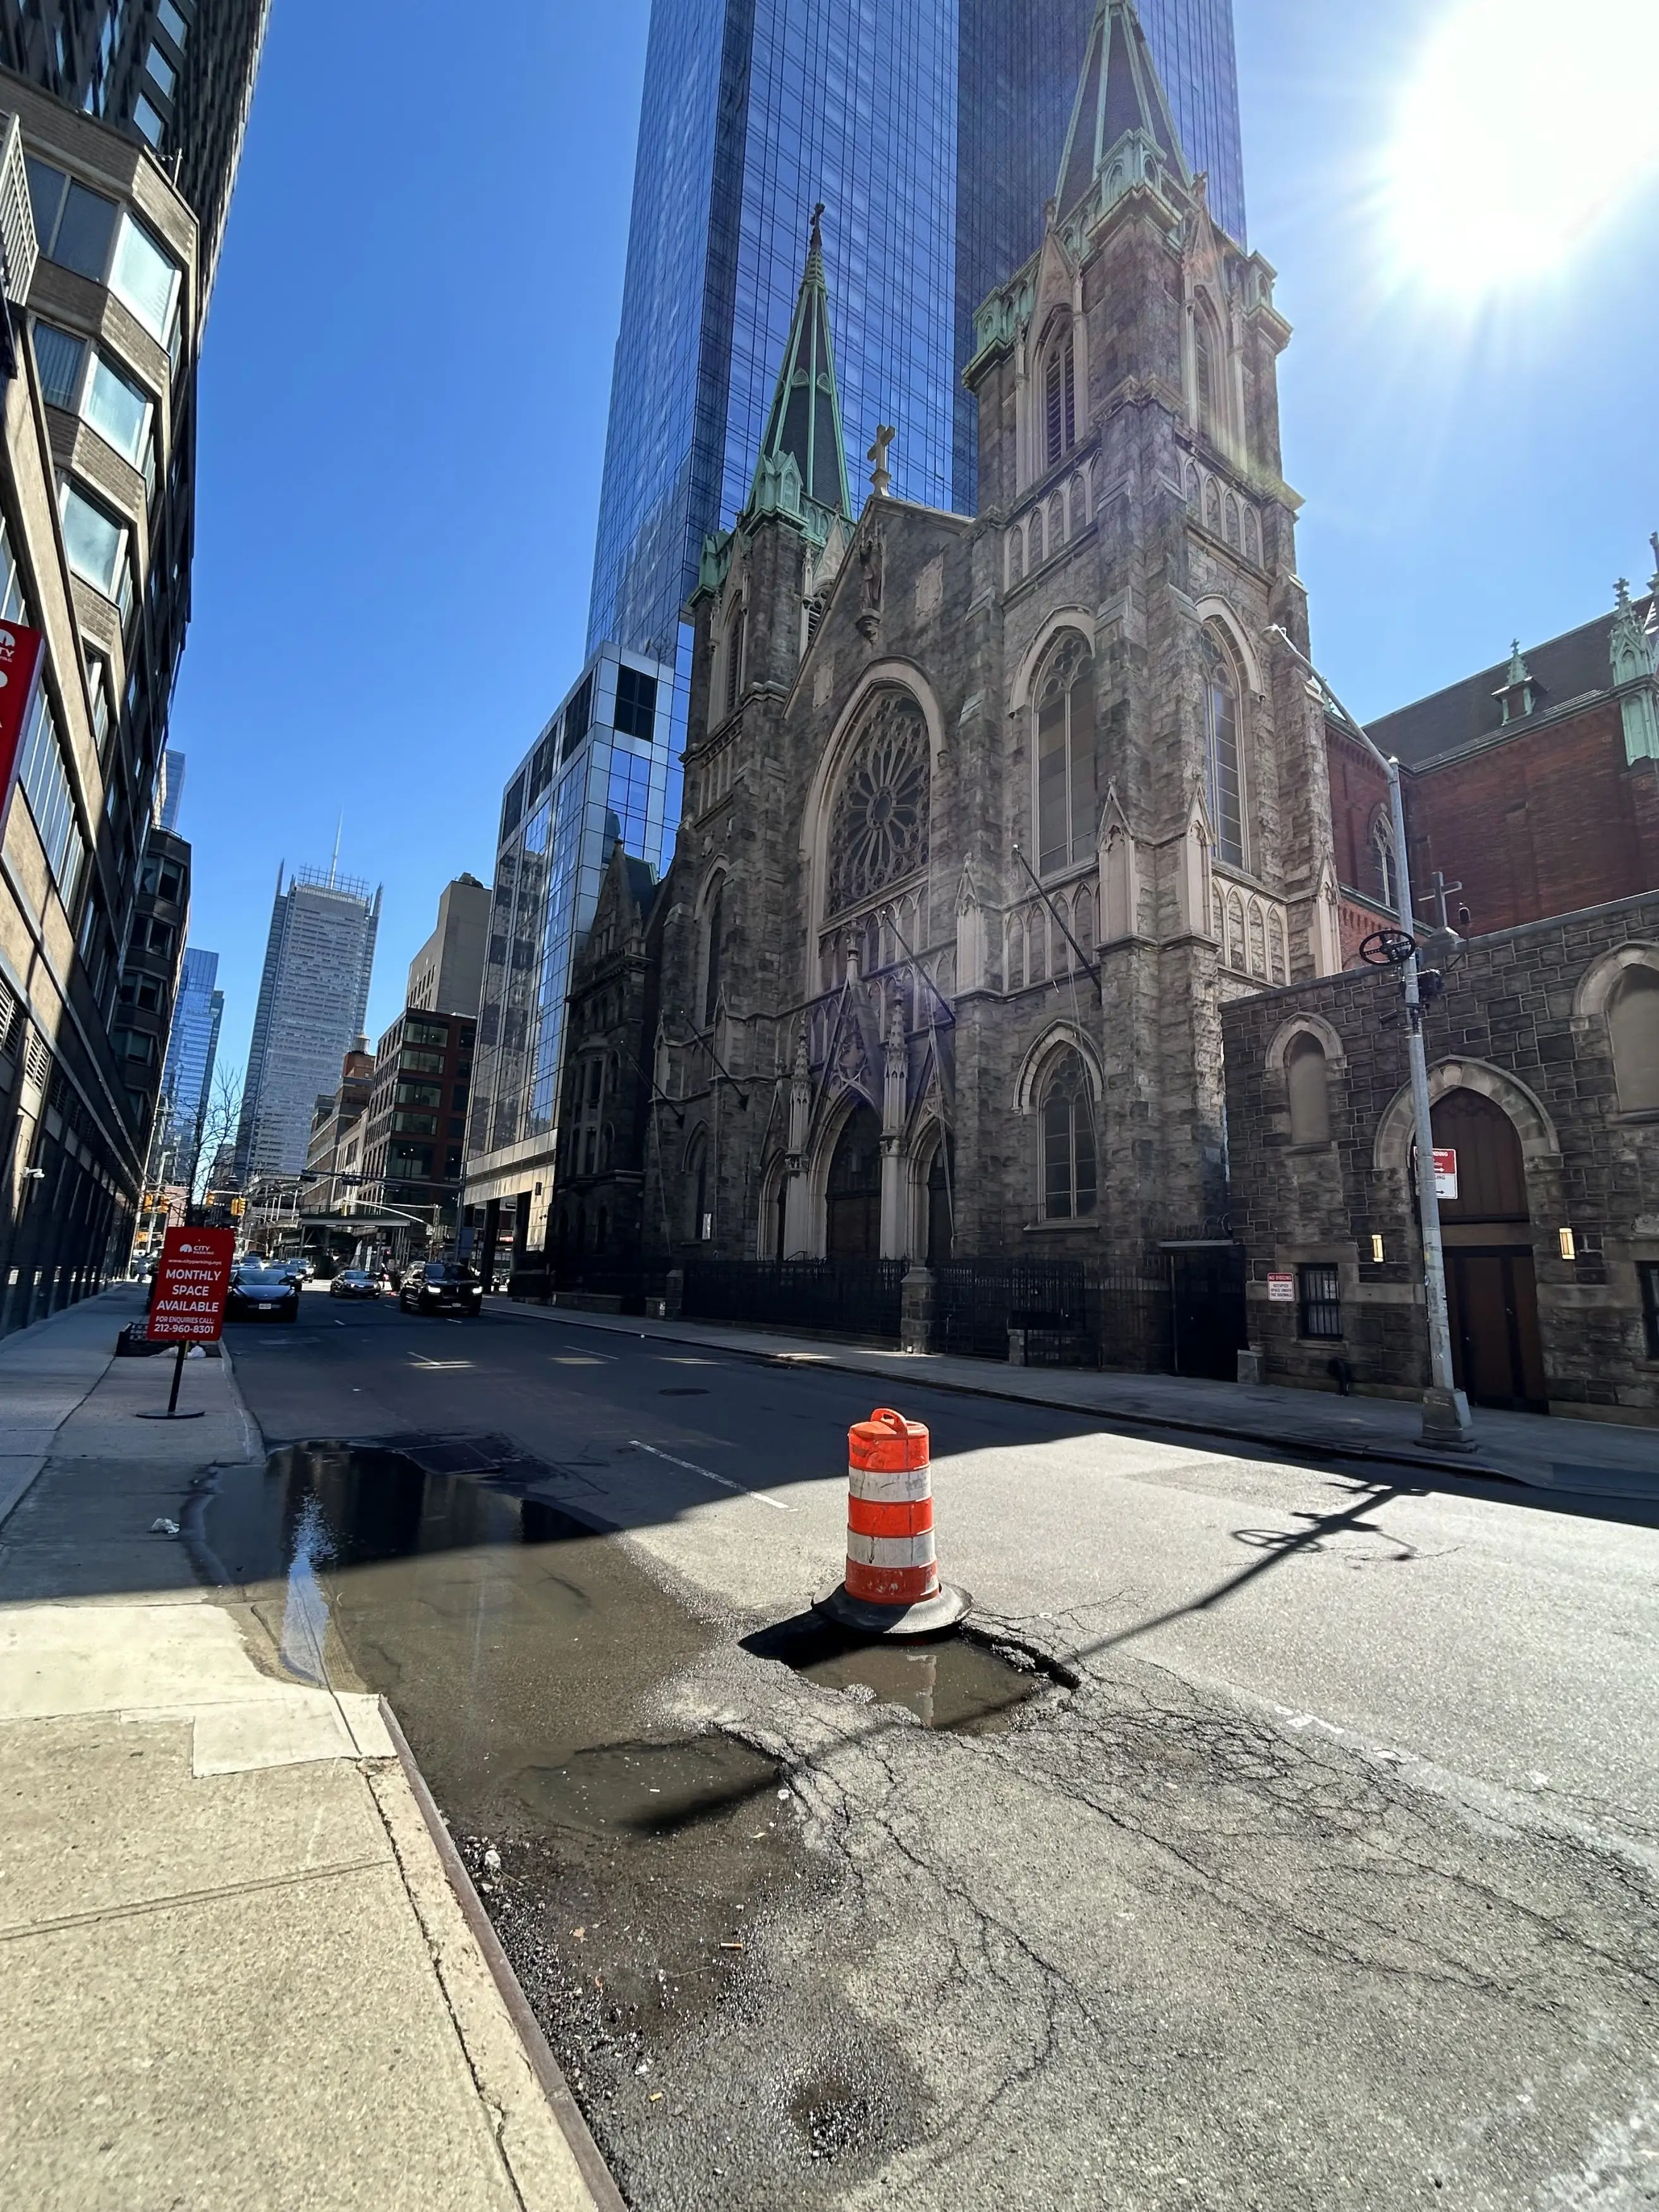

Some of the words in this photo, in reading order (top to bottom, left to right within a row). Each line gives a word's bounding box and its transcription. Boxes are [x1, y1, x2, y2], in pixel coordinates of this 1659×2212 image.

[166, 1269, 221, 1280] MONTHLY
[172, 1285, 209, 1296] SPACE
[156, 1300, 219, 1312] AVAILABLE
[154, 1324, 214, 1334] 212-960-8301
